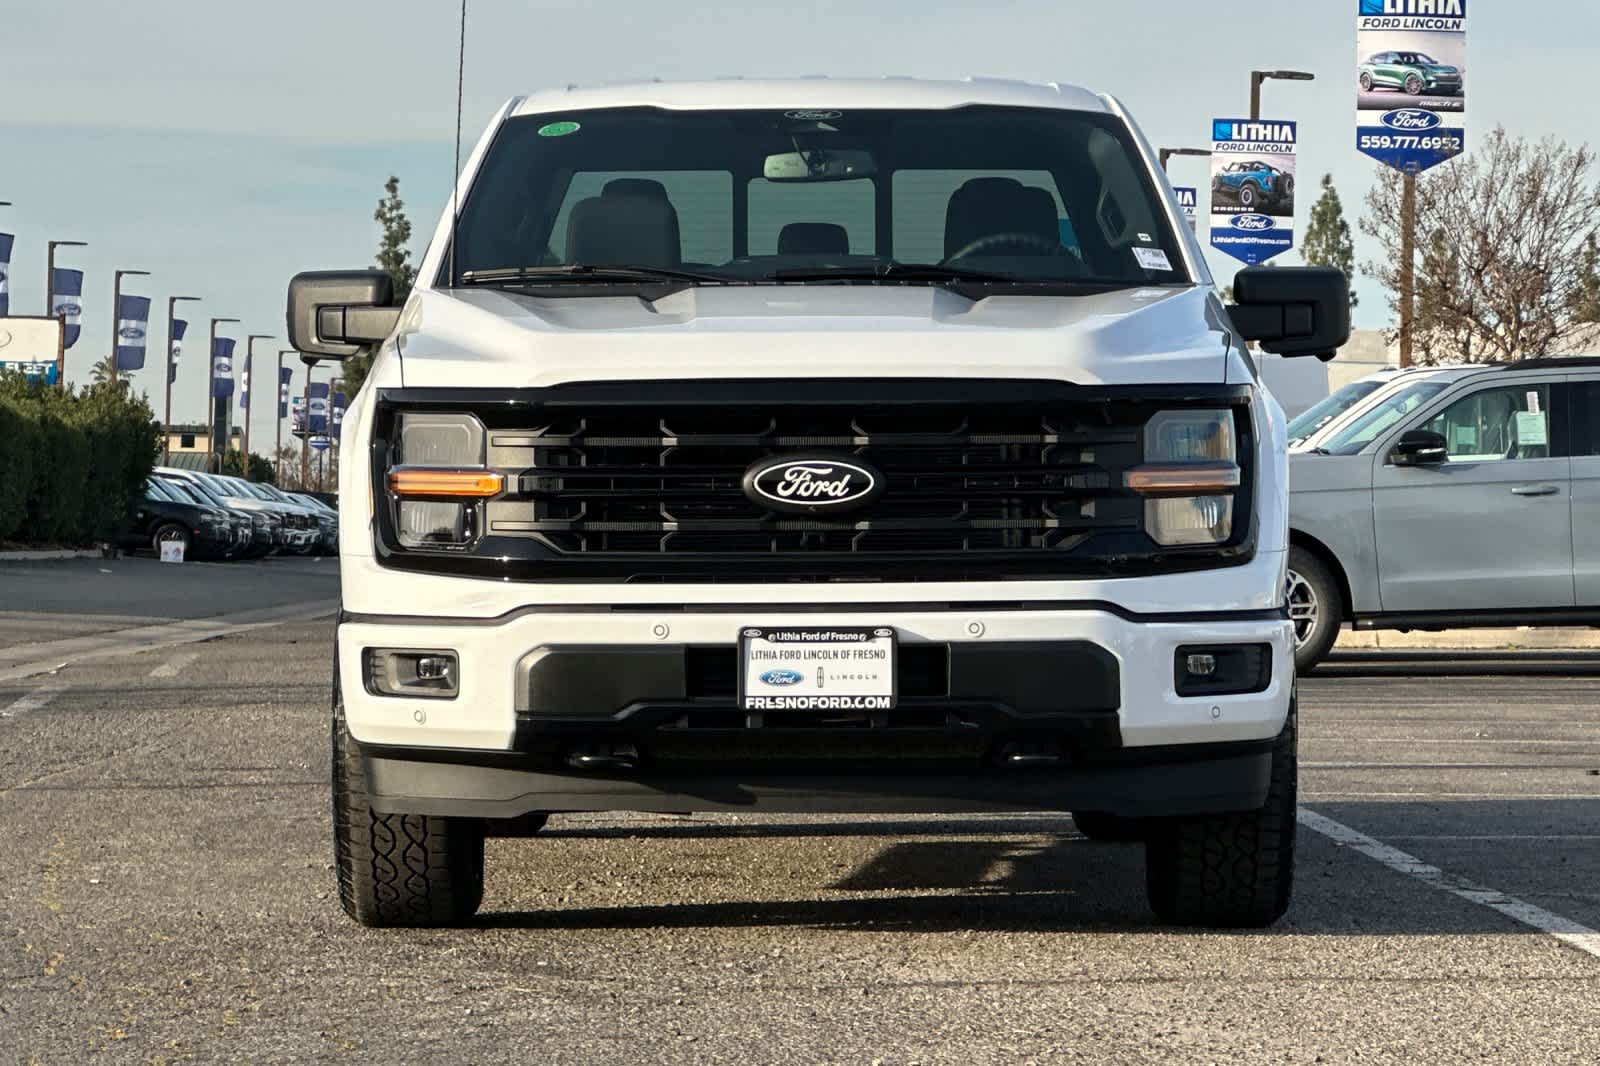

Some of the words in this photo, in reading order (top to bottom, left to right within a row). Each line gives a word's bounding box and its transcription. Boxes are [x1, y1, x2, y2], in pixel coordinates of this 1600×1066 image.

[1363, 18, 1400, 28] FORD
[1403, 19, 1461, 29] LINCOLN
[1392, 111, 1430, 127] Ford
[1231, 123, 1293, 141] LITHIA
[1215, 143, 1245, 151] FORD
[1247, 143, 1292, 153] LINCOLN
[1361, 135, 1460, 149] 559.777.6952
[1237, 215, 1267, 228] Ford
[777, 466, 851, 497] Ford
[777, 632, 800, 641] Lithia
[801, 632, 820, 641] Ford
[821, 632, 831, 641] of
[831, 632, 858, 641] Fresno
[751, 650, 778, 660] LITHIA
[780, 650, 801, 660] FORD
[804, 650, 838, 660] LINCOLN
[841, 650, 850, 660] OF
[853, 650, 885, 660] FRESNO
[768, 672, 795, 684] Ford
[745, 697, 891, 709] FRESNOFORD.COM
